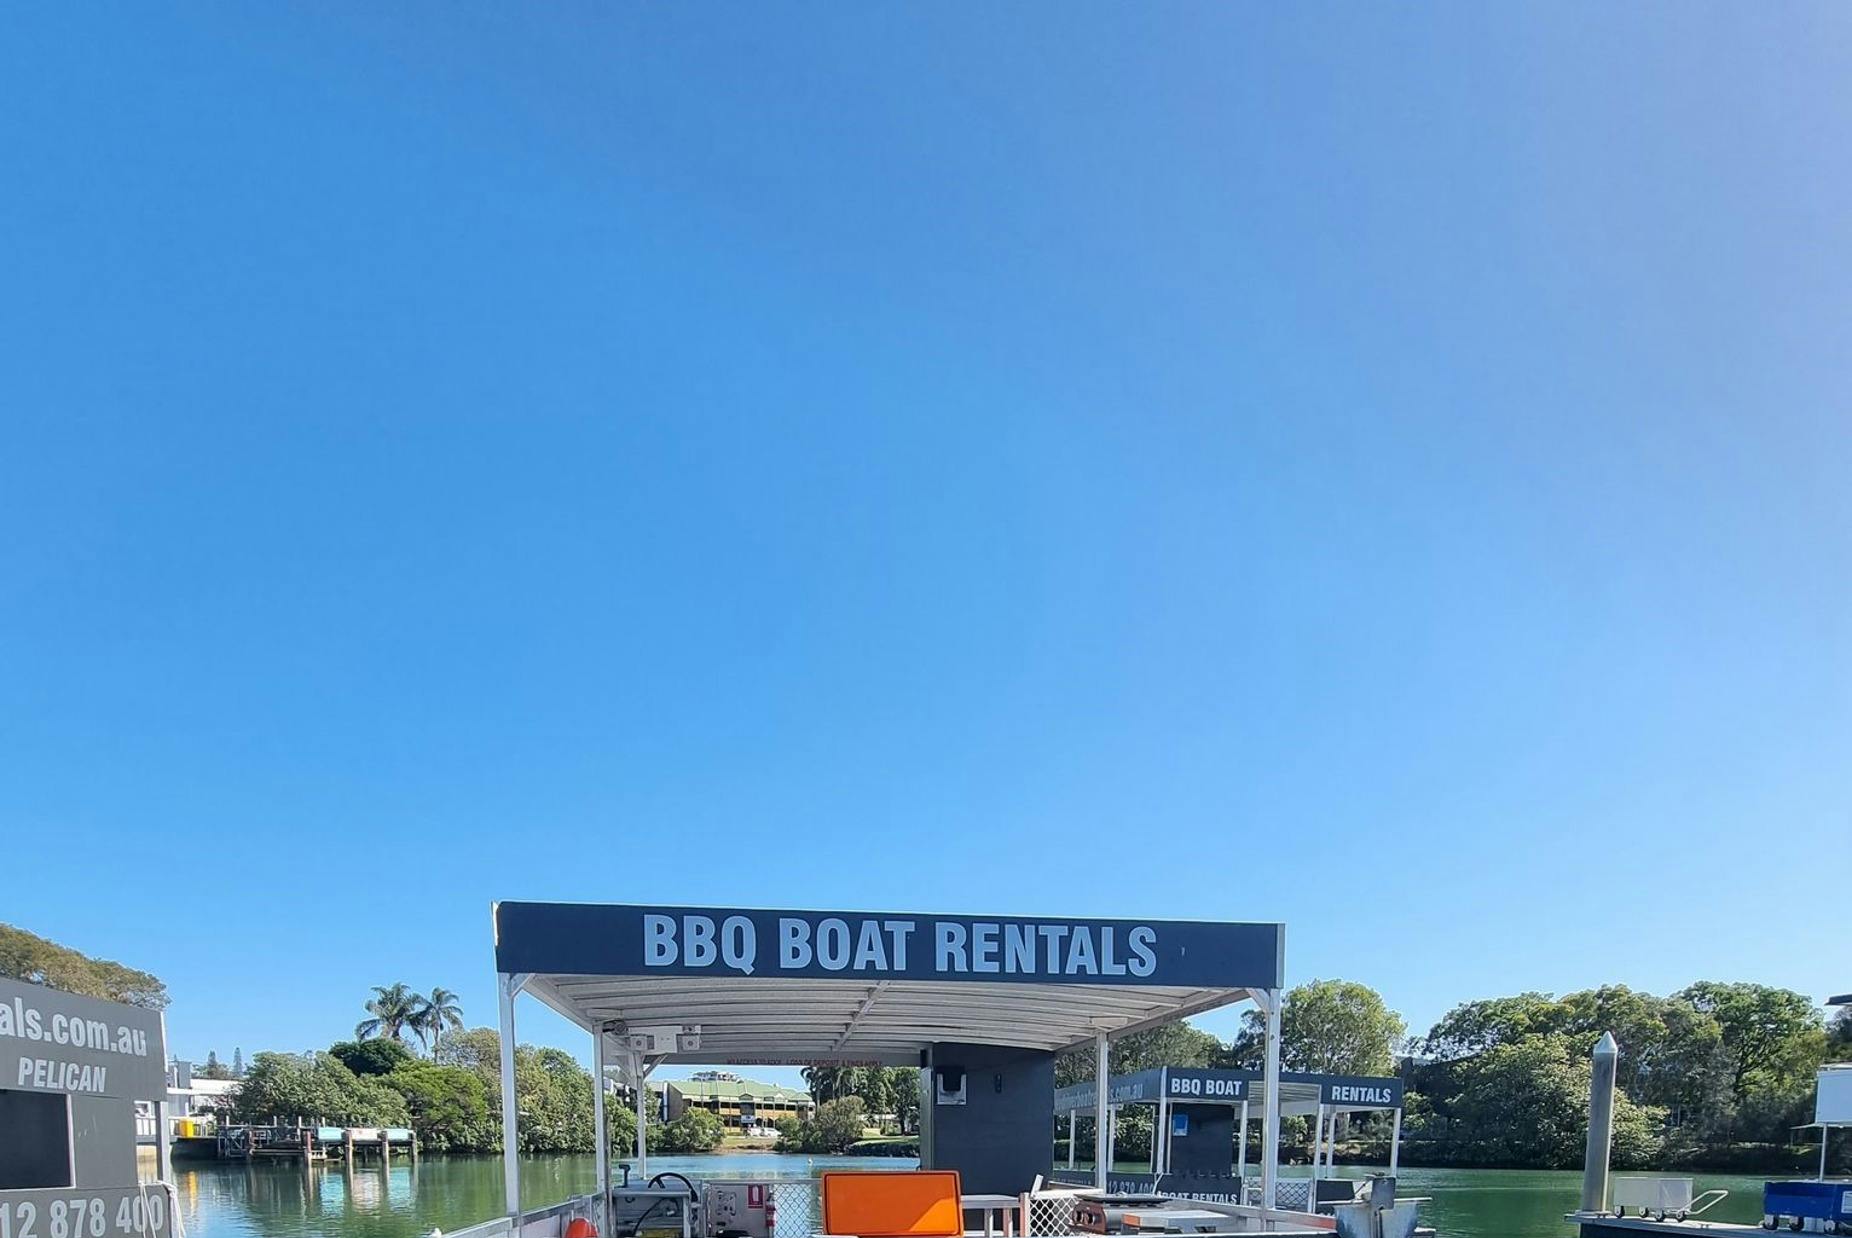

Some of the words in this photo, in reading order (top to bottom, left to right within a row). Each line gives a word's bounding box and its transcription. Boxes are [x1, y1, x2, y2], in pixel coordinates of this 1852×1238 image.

[643, 914, 757, 975] BBQ
[779, 917, 916, 971] BOAT
[935, 921, 1157, 977] RENTALS
[18, 1057, 107, 1093] PELICAN
[1171, 1078, 1200, 1096] BBQ
[1205, 1079, 1242, 1096] BOAT
[1331, 1085, 1392, 1103] RENTALS
[115, 1194, 164, 1234] 400
